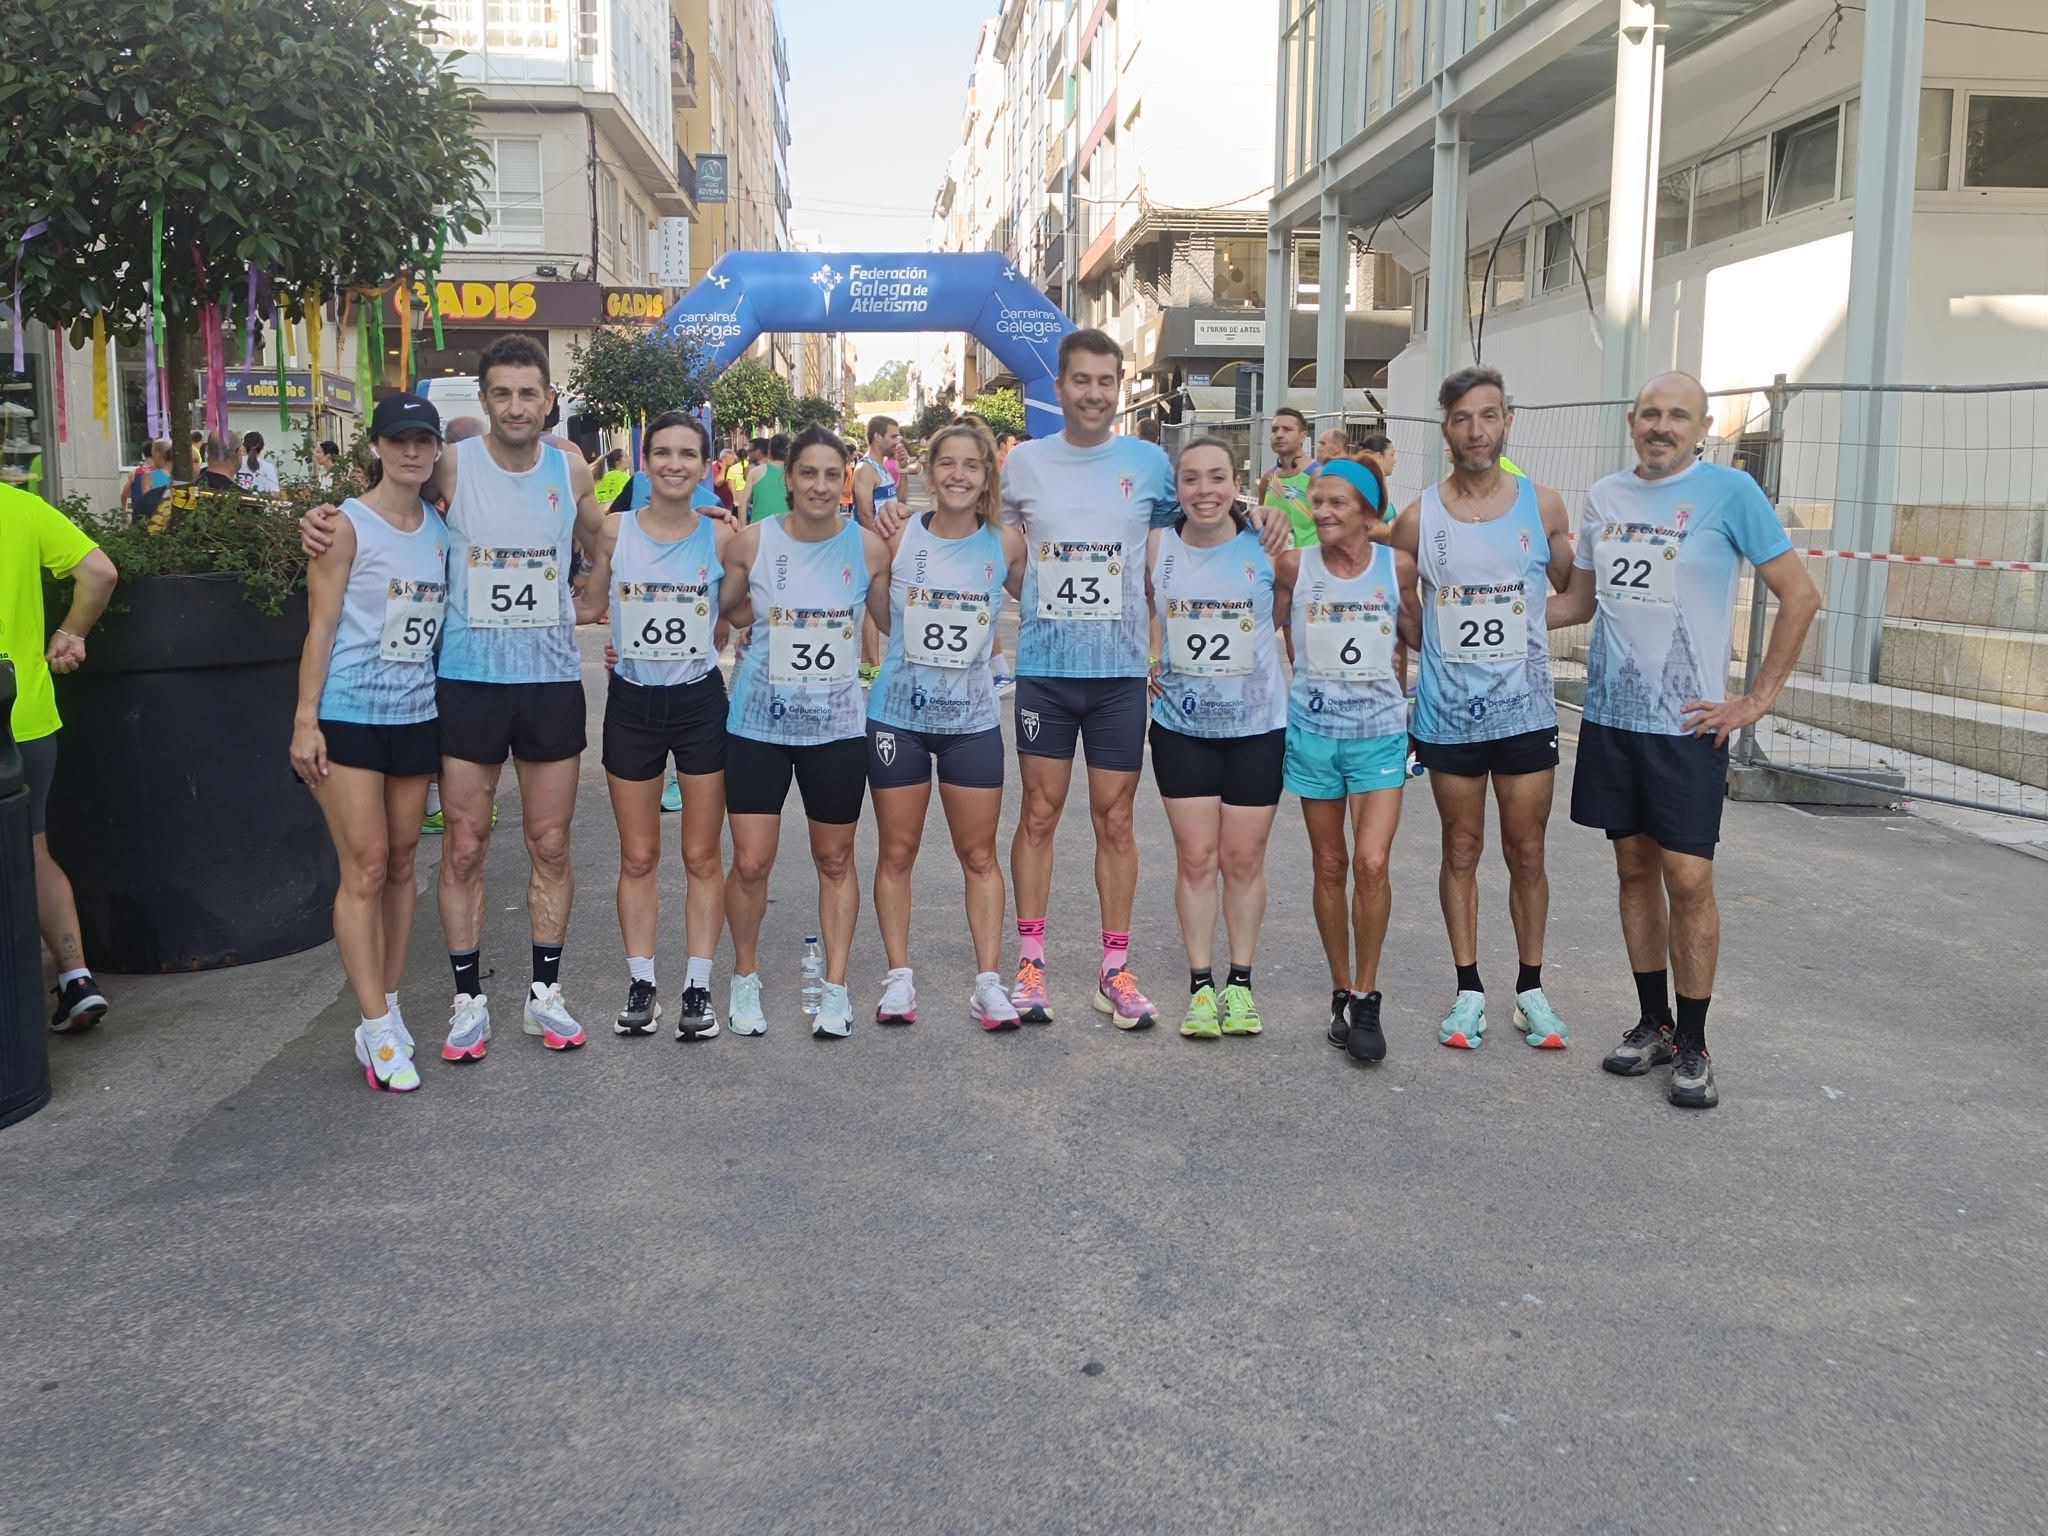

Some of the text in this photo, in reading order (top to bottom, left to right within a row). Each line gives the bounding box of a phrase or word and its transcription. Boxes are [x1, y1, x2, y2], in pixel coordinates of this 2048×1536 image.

[849, 264, 928, 280] Federación
[849, 280, 928, 300] Galega de
[606, 292, 665, 318] GADIS
[850, 298, 928, 313] Atletismo
[1000, 309, 1056, 320] Carreiras
[996, 320, 1062, 337] Galegas
[496, 551, 510, 559] EL
[1610, 558, 1652, 589] 22
[417, 584, 429, 593] EL
[490, 584, 537, 612] 54
[646, 586, 659, 594] EL
[932, 592, 945, 600] EL
[1056, 577, 1101, 604] 43
[1463, 588, 1477, 596] EL
[797, 610, 811, 619] EL
[1333, 604, 1347, 612] EL
[403, 617, 437, 646] 59
[641, 617, 687, 645] 68
[923, 623, 968, 652] 83
[1459, 618, 1505, 648] 28
[791, 643, 835, 670] 36
[1187, 634, 1230, 661] 92
[1340, 637, 1362, 665] 6
